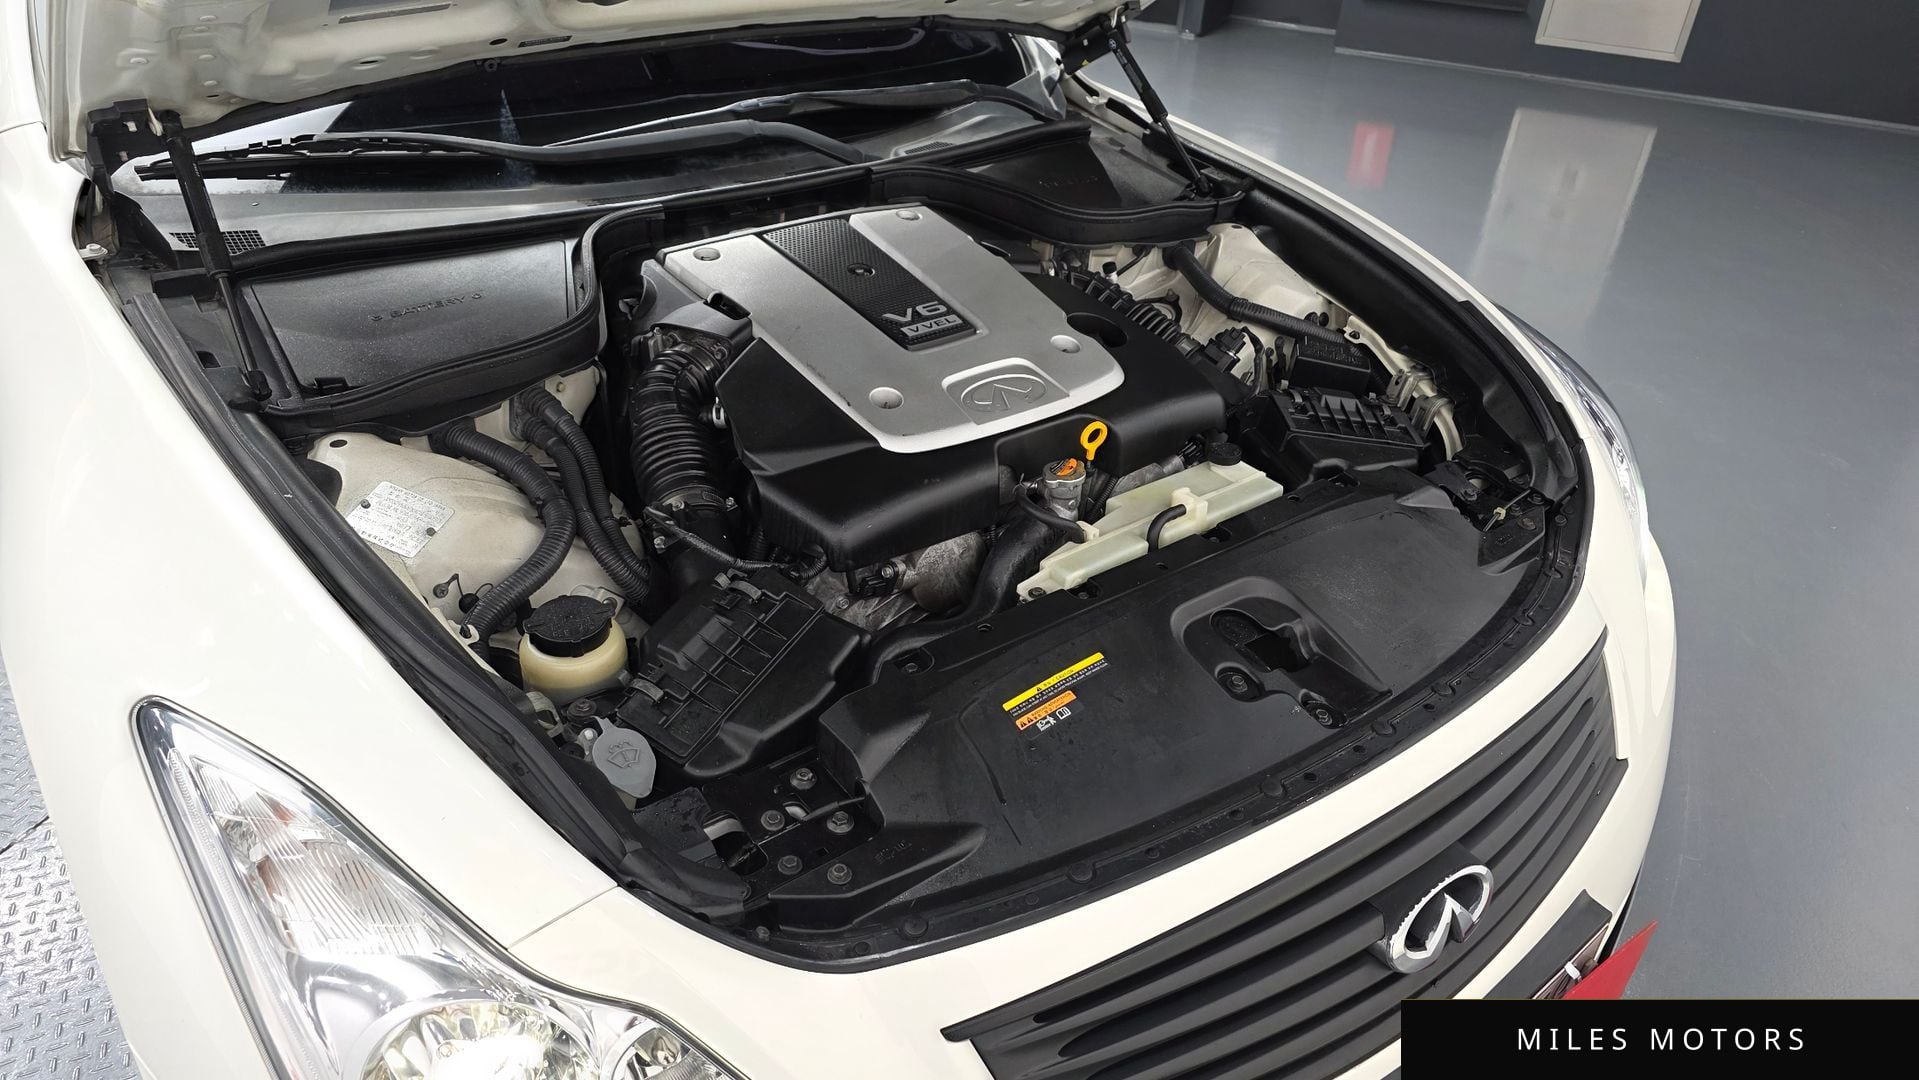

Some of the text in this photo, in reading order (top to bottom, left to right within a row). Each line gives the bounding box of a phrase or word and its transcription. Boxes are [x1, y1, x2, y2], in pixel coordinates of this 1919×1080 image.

[390, 295, 465, 318] BATTERY
[882, 301, 948, 322] V6
[908, 317, 957, 333] VVEL
